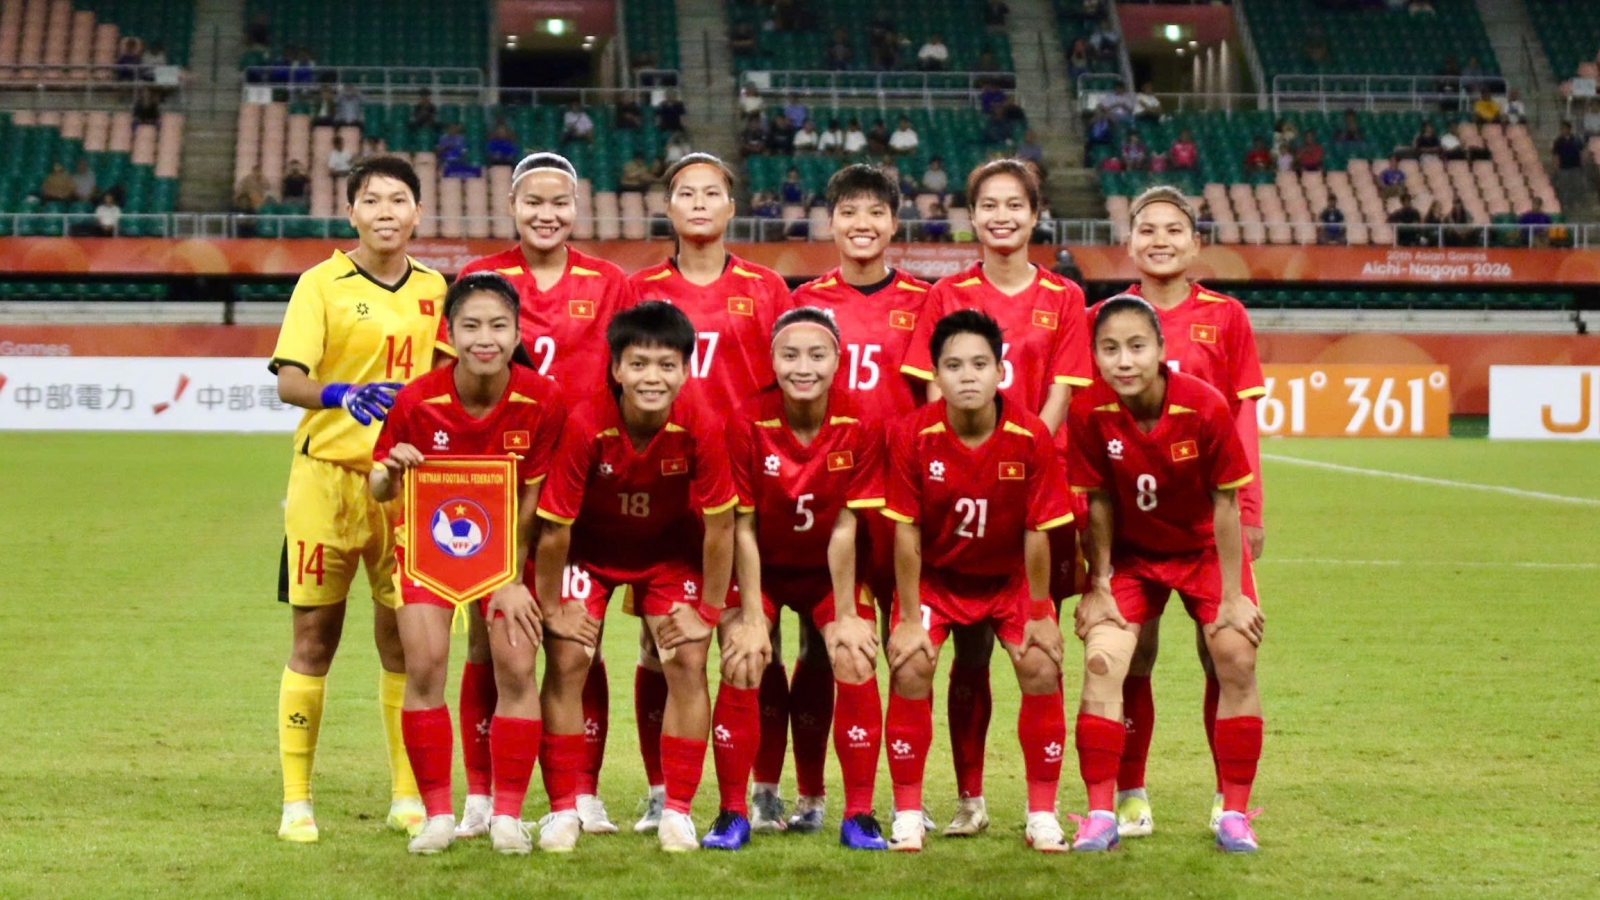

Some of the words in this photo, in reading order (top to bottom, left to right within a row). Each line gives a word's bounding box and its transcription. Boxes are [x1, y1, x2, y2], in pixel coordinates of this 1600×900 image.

[1362, 261, 1469, 282] Aichi-Nagoya
[1473, 263, 1513, 277] 2026
[1415, 251, 1445, 261] Asian
[1447, 251, 1487, 261] Games
[386, 335, 414, 379] 14
[534, 336, 556, 381] 2
[690, 331, 720, 378] 17
[847, 344, 882, 390] 15
[14, 383, 135, 411] 中部電力
[197, 384, 297, 411] 中部電
[1256, 371, 1327, 432] 61°
[418, 472, 442, 484] VIETNAM
[442, 472, 470, 484] FOOTBALL
[470, 472, 504, 485] FEDERATION
[1136, 473, 1158, 511] 8
[617, 492, 650, 518] 18
[793, 493, 815, 532] 5
[954, 497, 988, 538] 21
[297, 540, 326, 586] 14
[452, 541, 471, 549] VFF
[561, 564, 592, 599] 18
